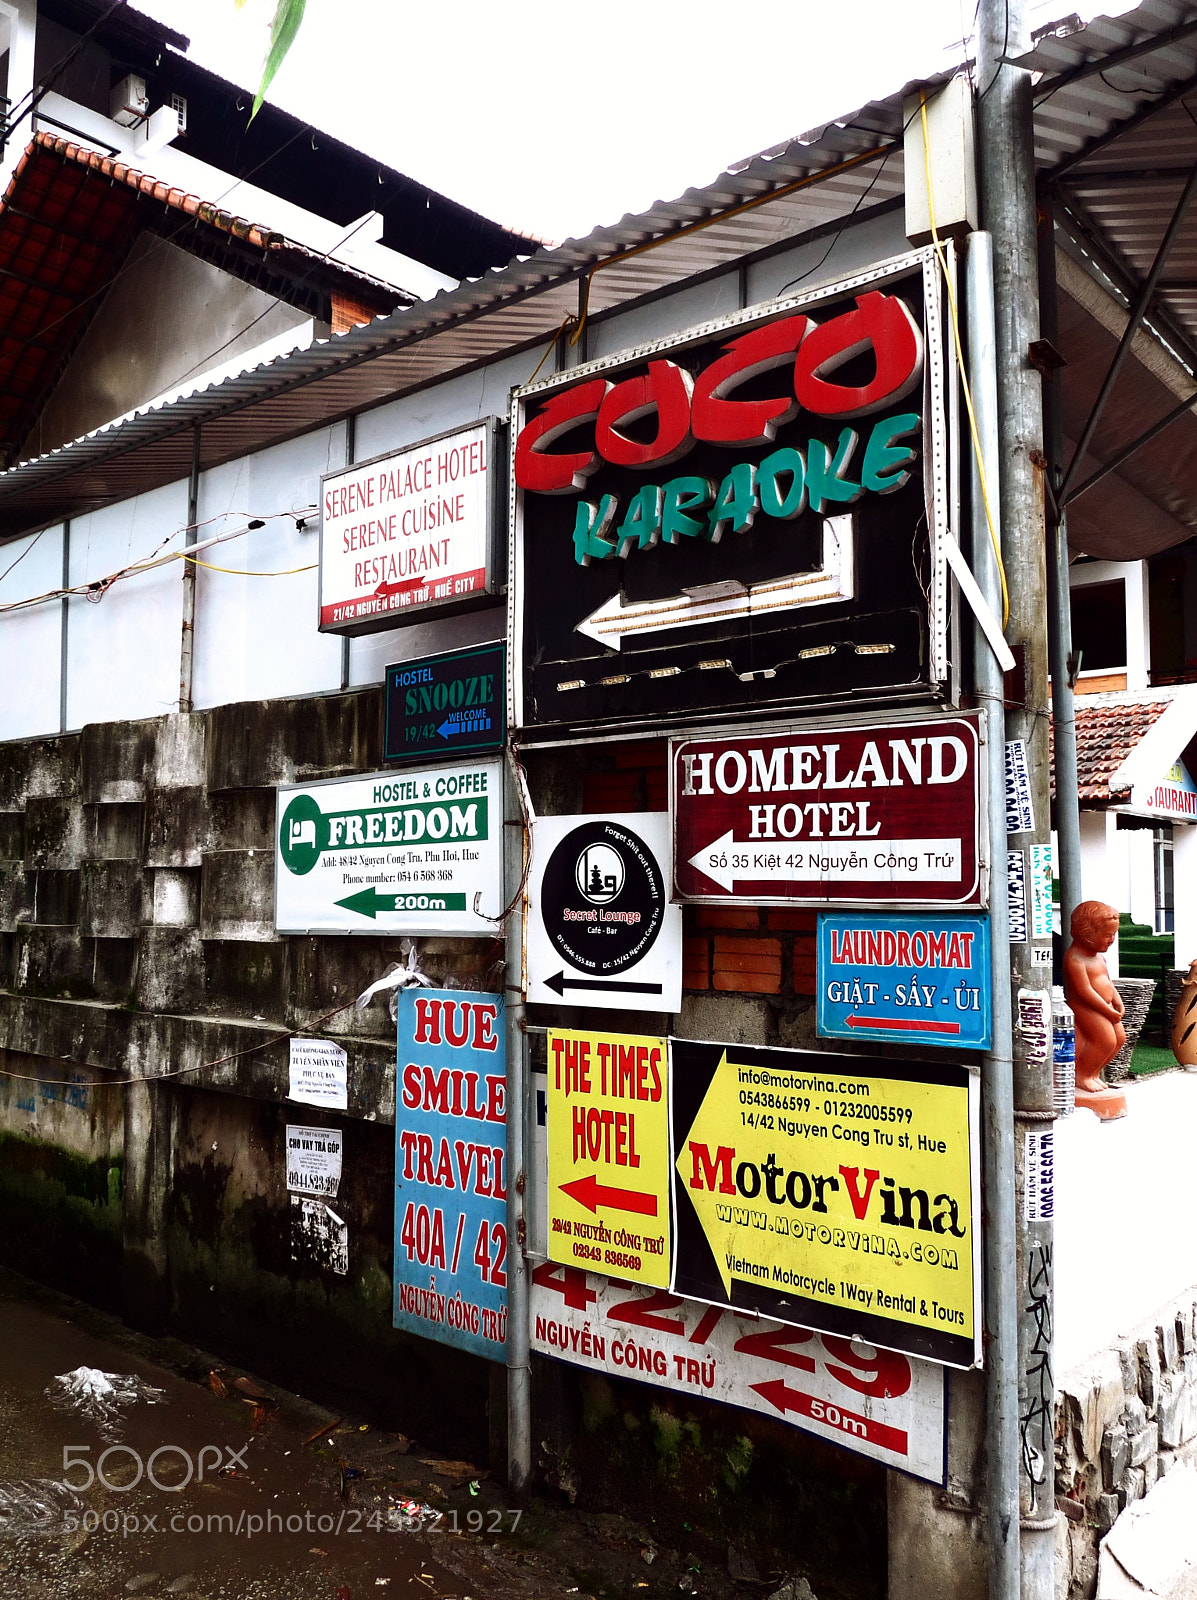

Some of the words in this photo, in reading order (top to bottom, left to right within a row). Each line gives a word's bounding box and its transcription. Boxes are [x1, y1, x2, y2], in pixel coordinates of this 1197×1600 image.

[515, 290, 923, 494] COCO
[325, 478, 375, 521] SERENE
[379, 457, 432, 503] PALACE
[437, 440, 488, 486] HOTEL
[572, 413, 921, 567] KARAOKE
[343, 515, 397, 554] SERENE
[354, 538, 450, 588] RESTAURANT
[333, 603, 355, 621] 21/42
[390, 591, 411, 610] CÔNG
[435, 579, 452, 597] HUẾ
[455, 576, 475, 595] CITY
[395, 668, 434, 688] HOSTEL
[404, 674, 494, 716] SNOOZE
[404, 723, 436, 743] 19/42
[448, 708, 487, 723] WELCOME
[681, 735, 968, 796] HOMELAND
[373, 781, 418, 803] HOSTEL
[423, 782, 431, 798] &
[435, 772, 488, 797] COFFEE
[328, 804, 478, 847] FREEDOM
[748, 801, 882, 838] HOTEL
[321, 856, 337, 868] Add:
[358, 853, 385, 869] Nguyen
[386, 852, 405, 867] Cong
[424, 850, 440, 862] Phu
[442, 850, 460, 862] Hoi,
[462, 849, 479, 860] Hue
[604, 826, 627, 843] Forget
[626, 839, 640, 854] Shit
[638, 853, 649, 868] out
[709, 850, 727, 868] Số
[732, 854, 749, 868] 35
[753, 853, 781, 872] Kiệt
[785, 854, 803, 868] 42
[808, 848, 868, 873] Nguyễn
[873, 851, 918, 872] Công
[924, 852, 955, 868] Trứ
[342, 873, 364, 884] Phone
[365, 872, 396, 884] number:
[397, 871, 411, 882] 054
[413, 871, 418, 881] 6
[420, 870, 435, 881] 568
[437, 869, 453, 881] 368
[394, 896, 446, 910] 200m
[563, 908, 597, 922] Secret
[599, 909, 641, 925] Lounge
[587, 926, 601, 934] Café
[628, 936, 648, 957] Nguyen
[644, 920, 657, 936] Cong
[651, 907, 660, 919] Tru
[830, 929, 975, 969] LAUNDROMAT
[827, 976, 879, 1010] GIẶT
[895, 974, 937, 1008] SẤY
[954, 980, 981, 1011] ỦI
[414, 998, 498, 1052] HUE
[552, 1038, 592, 1098] THE
[597, 1042, 662, 1102] TIMES
[738, 1068, 870, 1097] info@motorvina.com
[402, 1063, 507, 1124] SMILE
[738, 1090, 811, 1113] 0543866599
[823, 1100, 913, 1124] 01232005599
[289, 1138, 301, 1149] CHO
[301, 1139, 314, 1151] VAY
[314, 1138, 326, 1152] TRẢ
[327, 1140, 340, 1154] GÓP
[572, 1105, 640, 1168] HOTEL
[740, 1111, 775, 1130] 14/42
[778, 1119, 828, 1139] Nguyen
[832, 1124, 870, 1147] Cong
[874, 1128, 894, 1146] Tru
[898, 1133, 914, 1151] st,
[918, 1134, 947, 1153] Hue
[401, 1130, 507, 1202] TRAVEL
[688, 1140, 967, 1238] MotorVina
[401, 1202, 447, 1270] 40A
[451, 1212, 466, 1275] /
[474, 1219, 507, 1288] 42
[552, 1217, 572, 1235] 29/42
[573, 1220, 612, 1244] NGUYỄN
[613, 1228, 641, 1251] CÔNG
[643, 1236, 665, 1255] TRỨ
[572, 1242, 602, 1262] 02343
[604, 1250, 642, 1271] 836569
[399, 1275, 445, 1324] NGUYỄN
[447, 1290, 480, 1335] CÔNG
[725, 1253, 770, 1280] Vietnam
[772, 1265, 836, 1297] Motorcycle
[840, 1281, 873, 1308] 1Way
[876, 1293, 916, 1315] Rental
[920, 1299, 928, 1317] &
[931, 1301, 965, 1326] Tours
[535, 1315, 606, 1361] NGUYỄN
[611, 1338, 667, 1376] CÔNG
[673, 1355, 717, 1389] TRỨ
[810, 1400, 868, 1438] 50m
